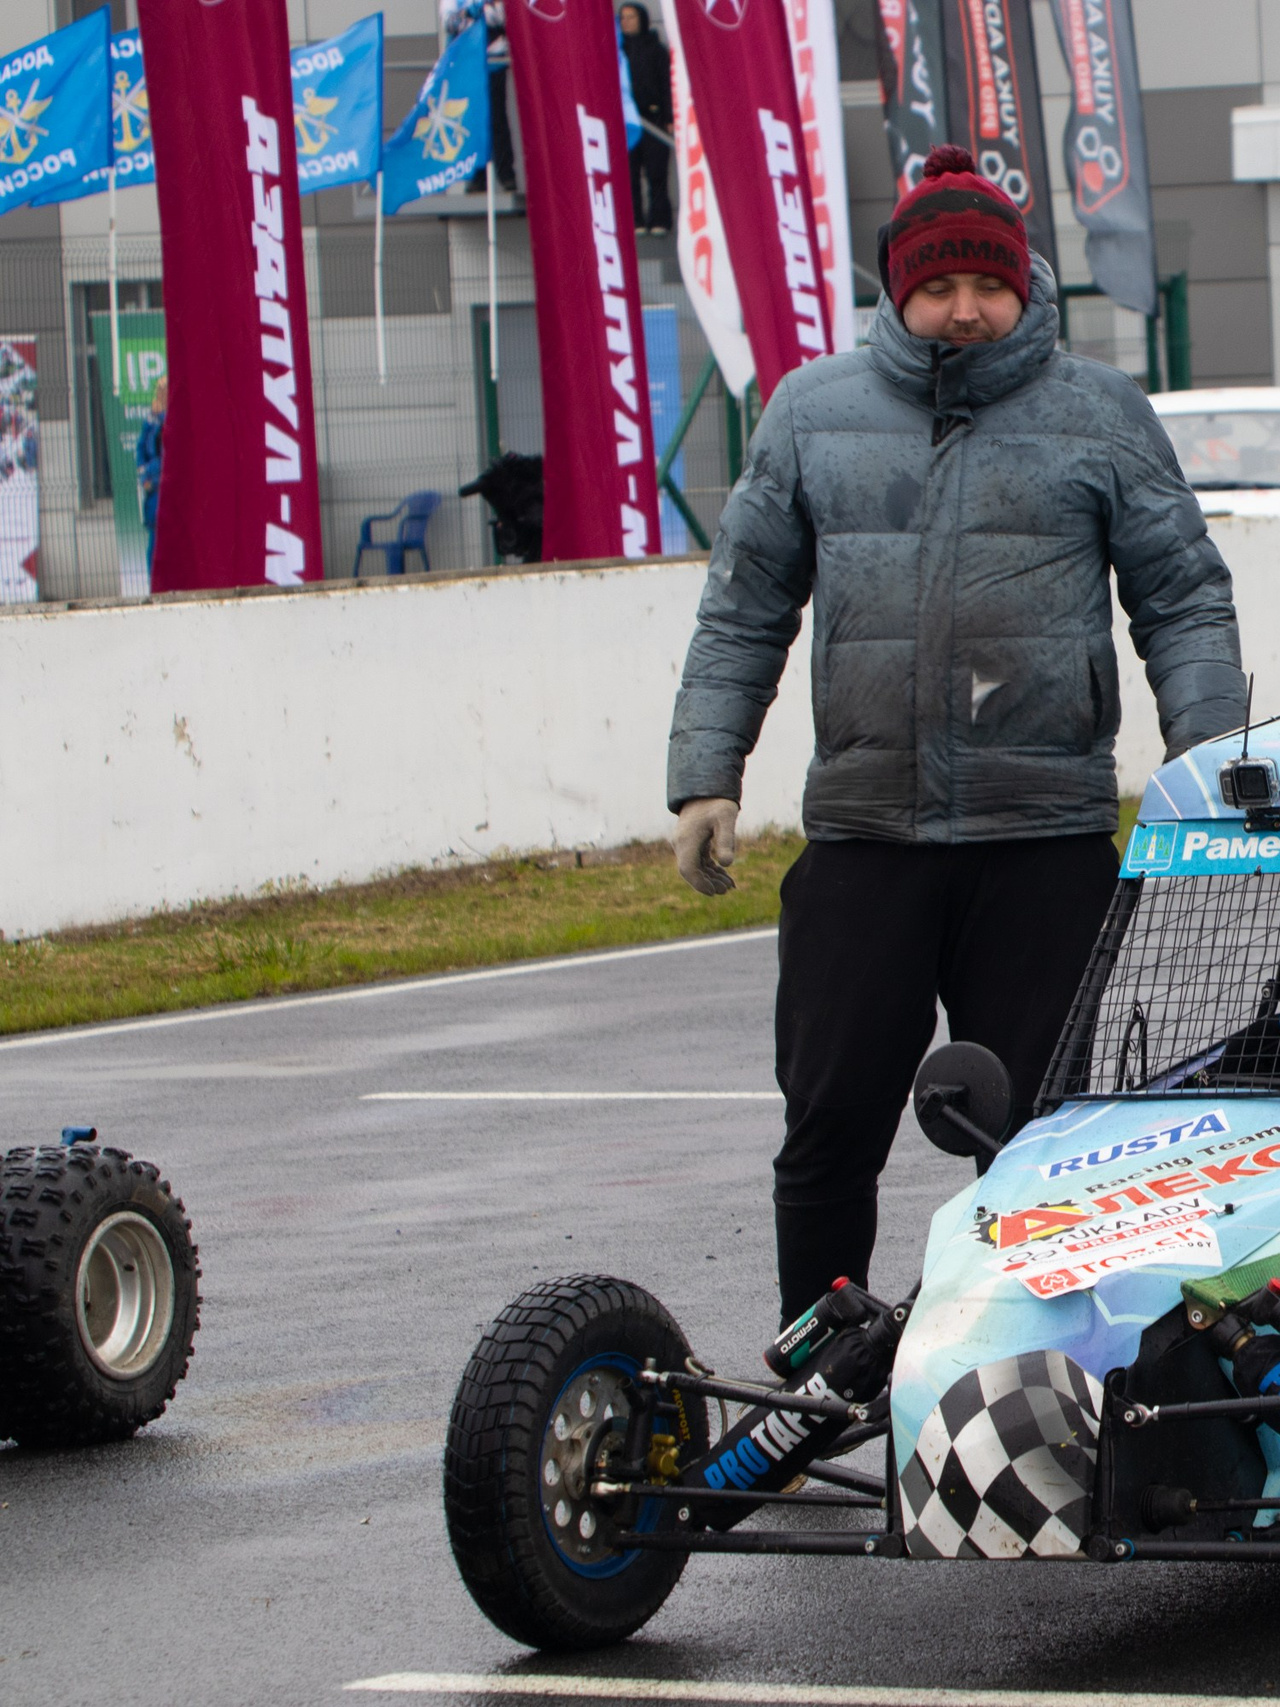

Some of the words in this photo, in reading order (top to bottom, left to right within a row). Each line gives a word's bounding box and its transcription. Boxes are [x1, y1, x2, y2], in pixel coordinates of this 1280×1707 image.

[1047, 1112, 1228, 1179] RUSTA
[1084, 1154, 1194, 1194] Racing
[1049, 1219, 1136, 1244] YUKA
[1143, 1197, 1202, 1222] ADV
[1076, 1234, 1118, 1251] PRO
[1123, 1211, 1203, 1238] RACING
[779, 1316, 820, 1355] CFMOTO
